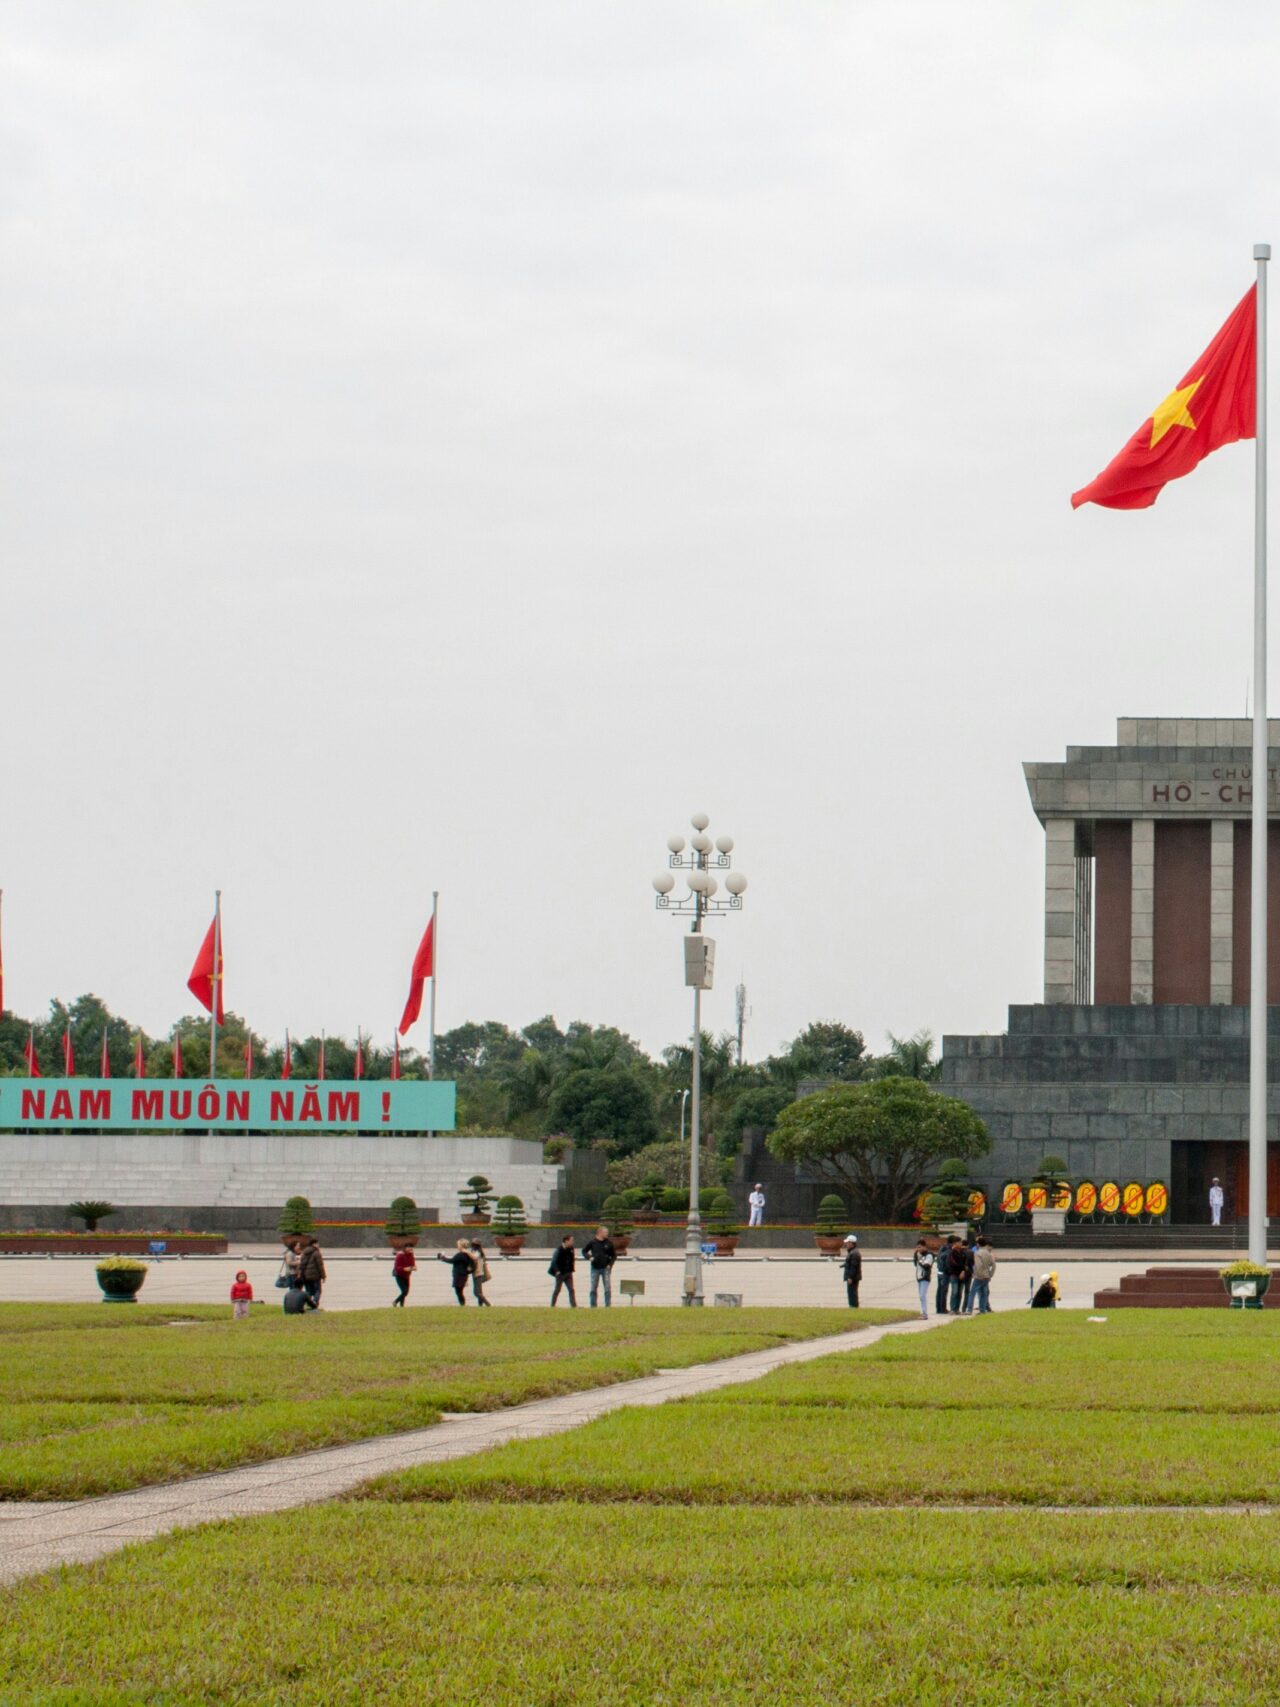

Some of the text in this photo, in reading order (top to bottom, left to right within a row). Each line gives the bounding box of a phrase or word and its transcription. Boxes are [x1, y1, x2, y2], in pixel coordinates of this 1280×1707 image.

[21, 1089, 111, 1120] NAM
[131, 1084, 250, 1121] MUÔN
[270, 1085, 360, 1122] NĂM
